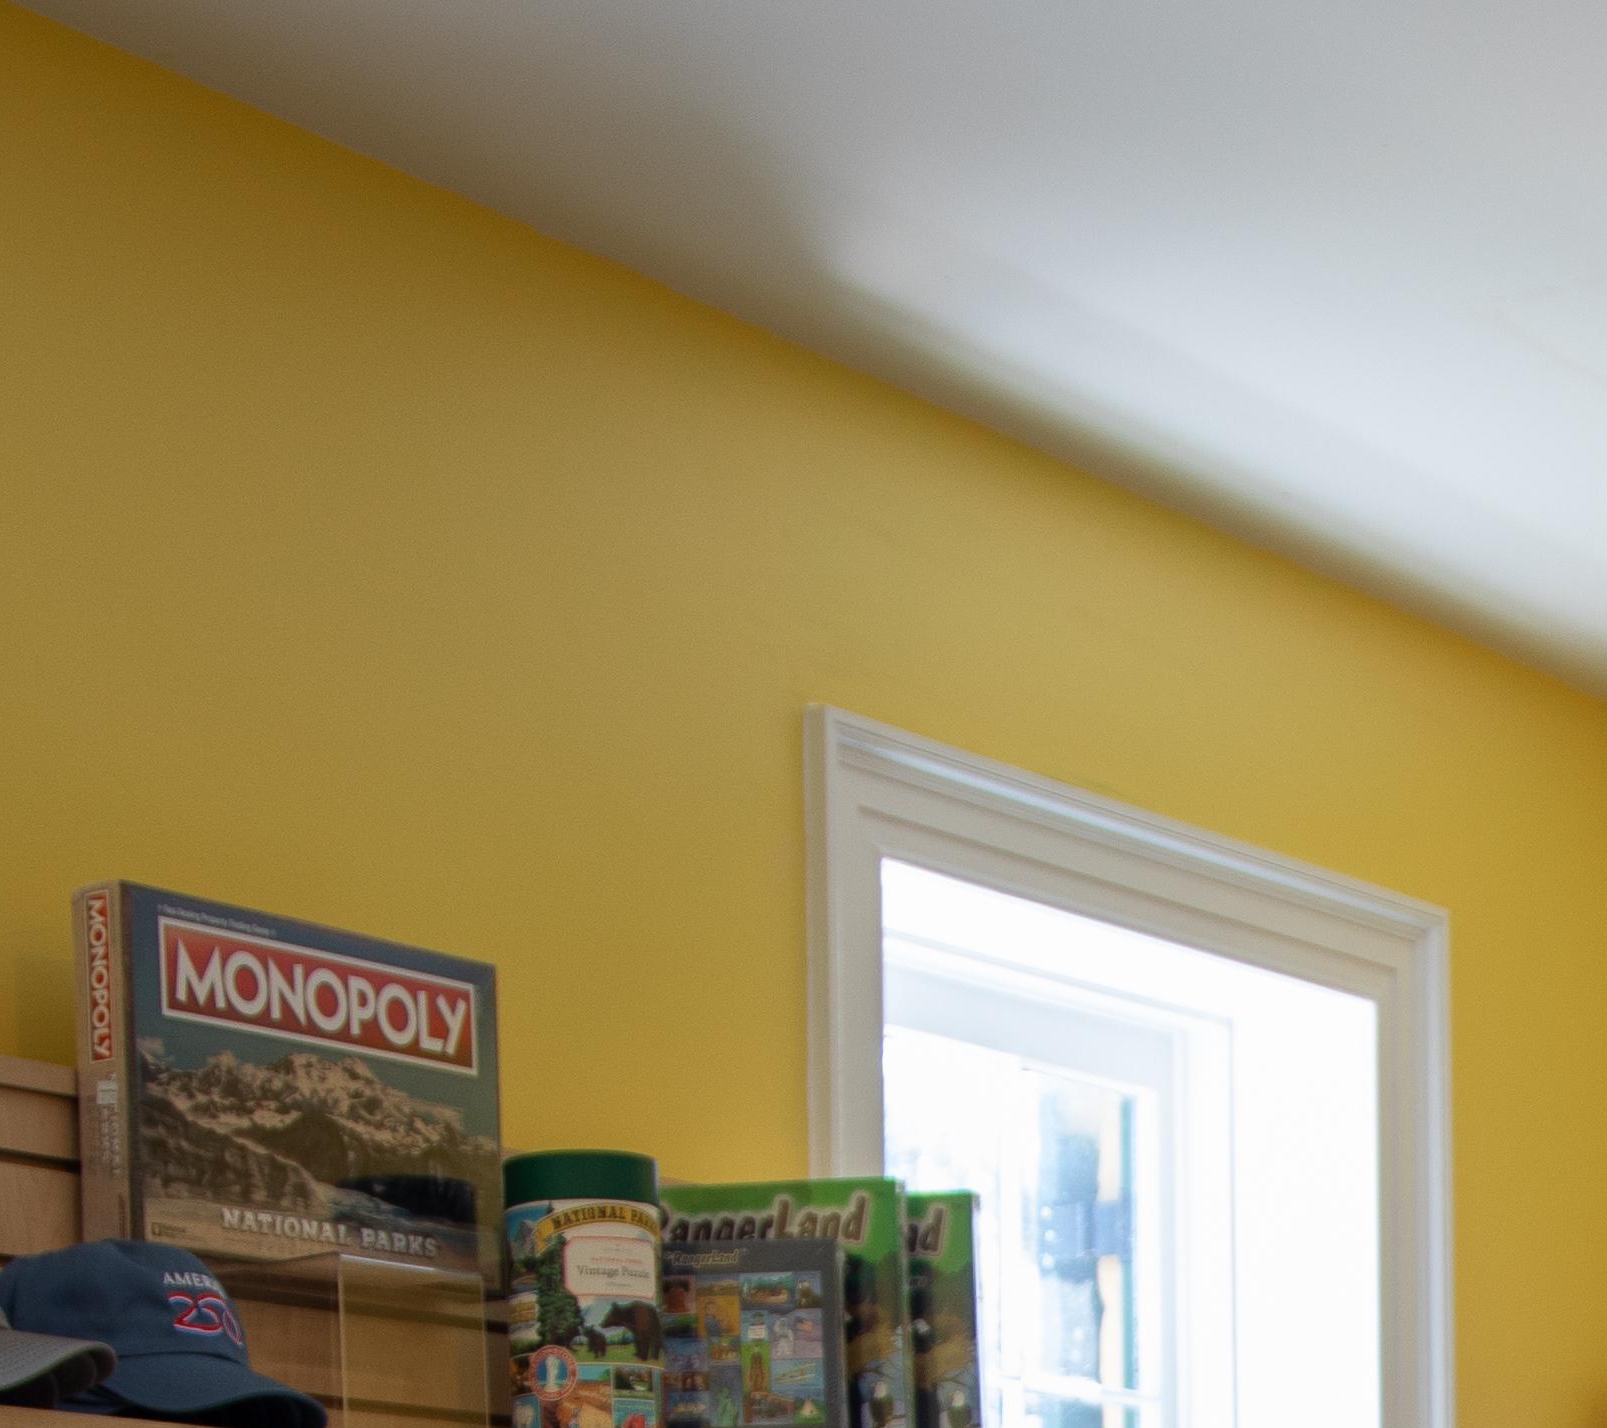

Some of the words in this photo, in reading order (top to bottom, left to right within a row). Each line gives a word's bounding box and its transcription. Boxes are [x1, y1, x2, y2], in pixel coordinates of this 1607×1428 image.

[88, 894, 112, 1060] MONOPOLY
[173, 936, 468, 1058] MONOPOLY
[219, 1205, 349, 1246] NATIONAL
[359, 1224, 441, 1259] PARKS
